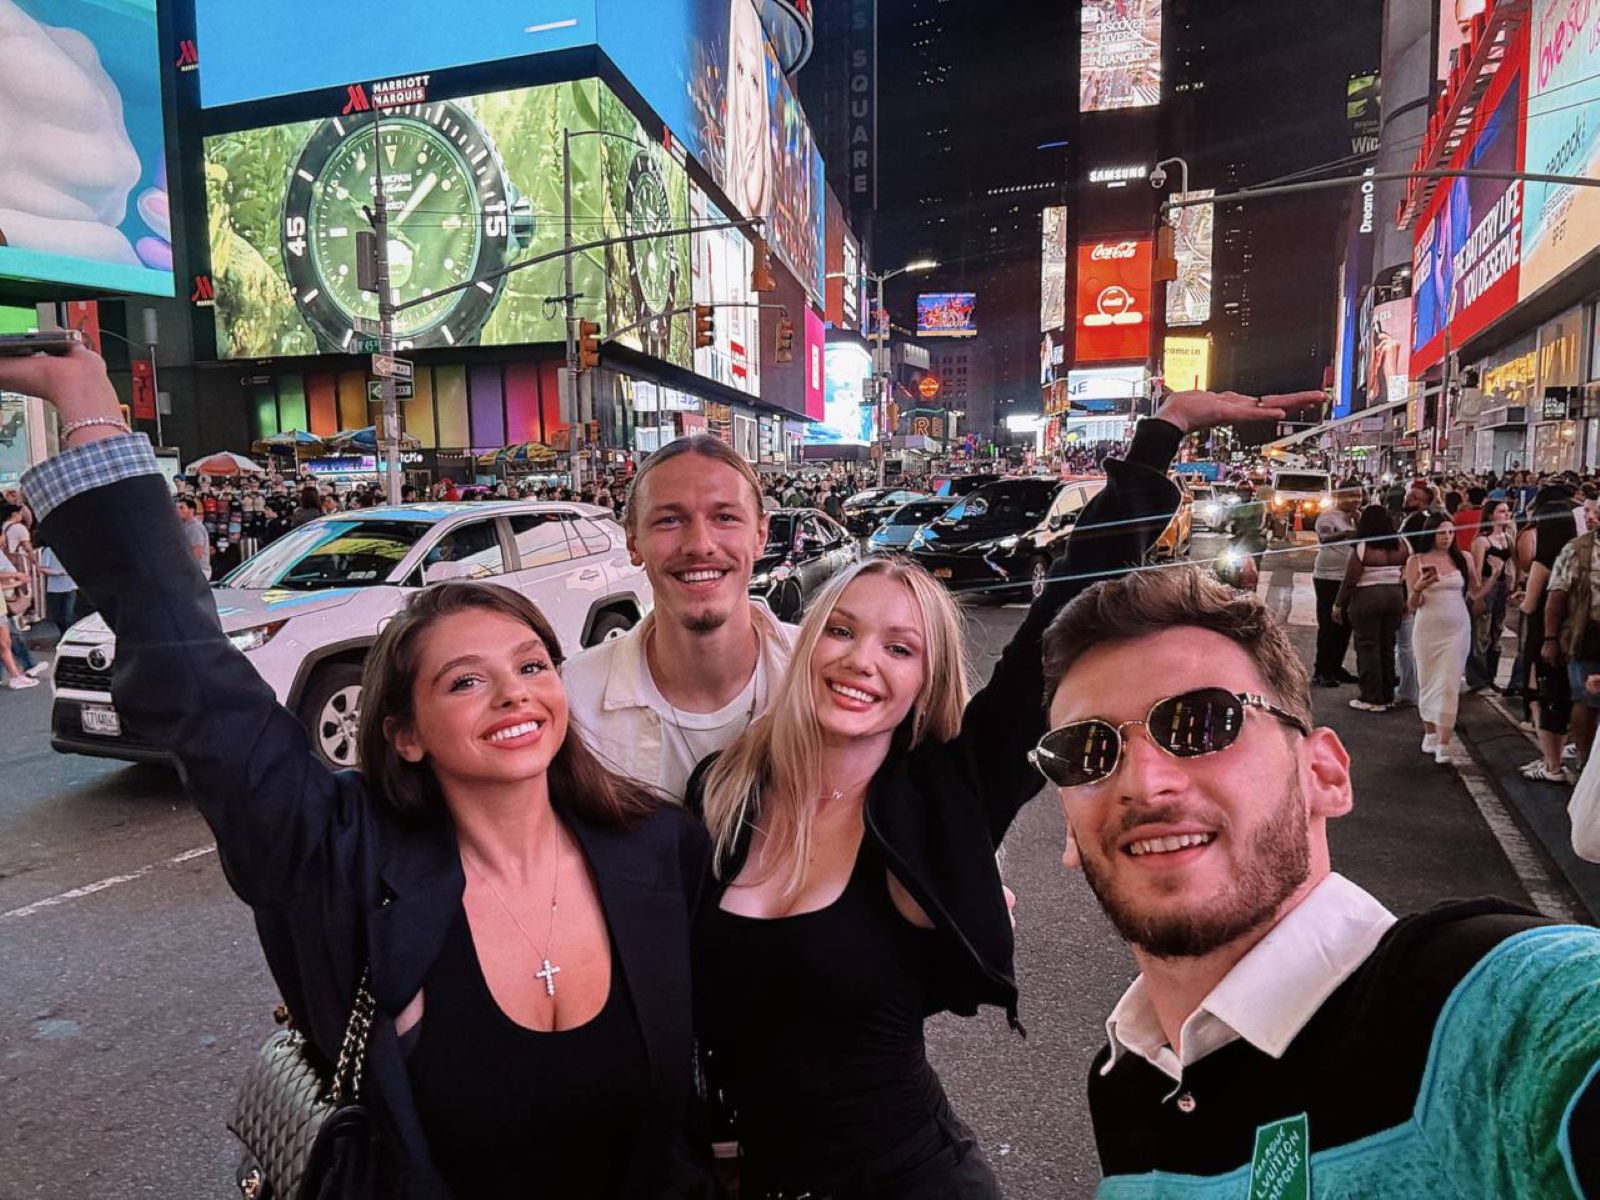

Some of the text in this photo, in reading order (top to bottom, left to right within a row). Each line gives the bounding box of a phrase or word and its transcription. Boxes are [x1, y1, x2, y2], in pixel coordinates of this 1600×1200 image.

[372, 75, 430, 94] MARRIOTT
[374, 89, 424, 105] MARQUIS
[852, 49, 868, 193] SQUARE
[1089, 166, 1147, 182] SAMSUNG
[1543, 114, 1581, 201] peacock
[1359, 194, 1374, 233] Dream
[1500, 179, 1521, 233] LIFE
[1480, 221, 1521, 297] DESERVE
